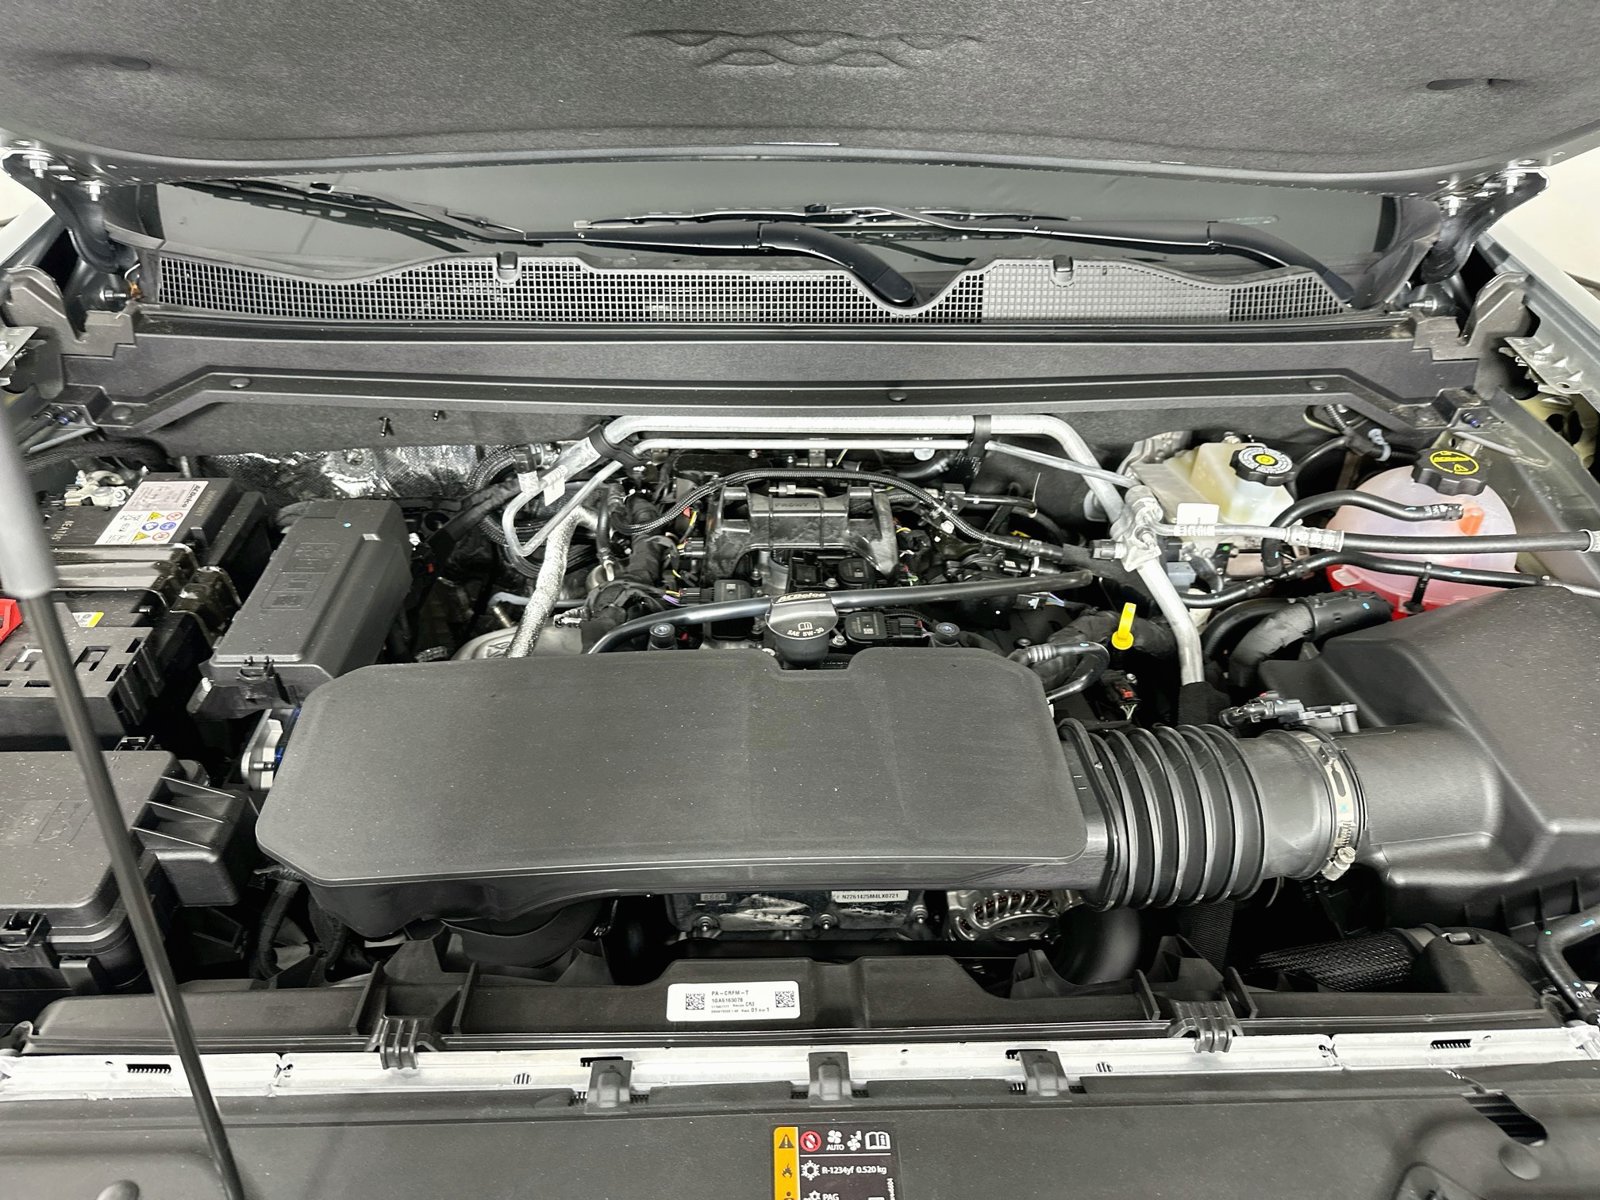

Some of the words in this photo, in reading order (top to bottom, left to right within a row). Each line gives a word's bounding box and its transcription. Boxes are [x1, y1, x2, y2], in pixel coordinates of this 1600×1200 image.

[775, 592, 827, 603] ACDelco
[786, 629, 800, 637] SAE
[802, 627, 825, 637] 5W-30
[821, 1165, 854, 1175] R-1234yf
[856, 1165, 876, 1174] 0.520
[877, 1165, 887, 1175] kg
